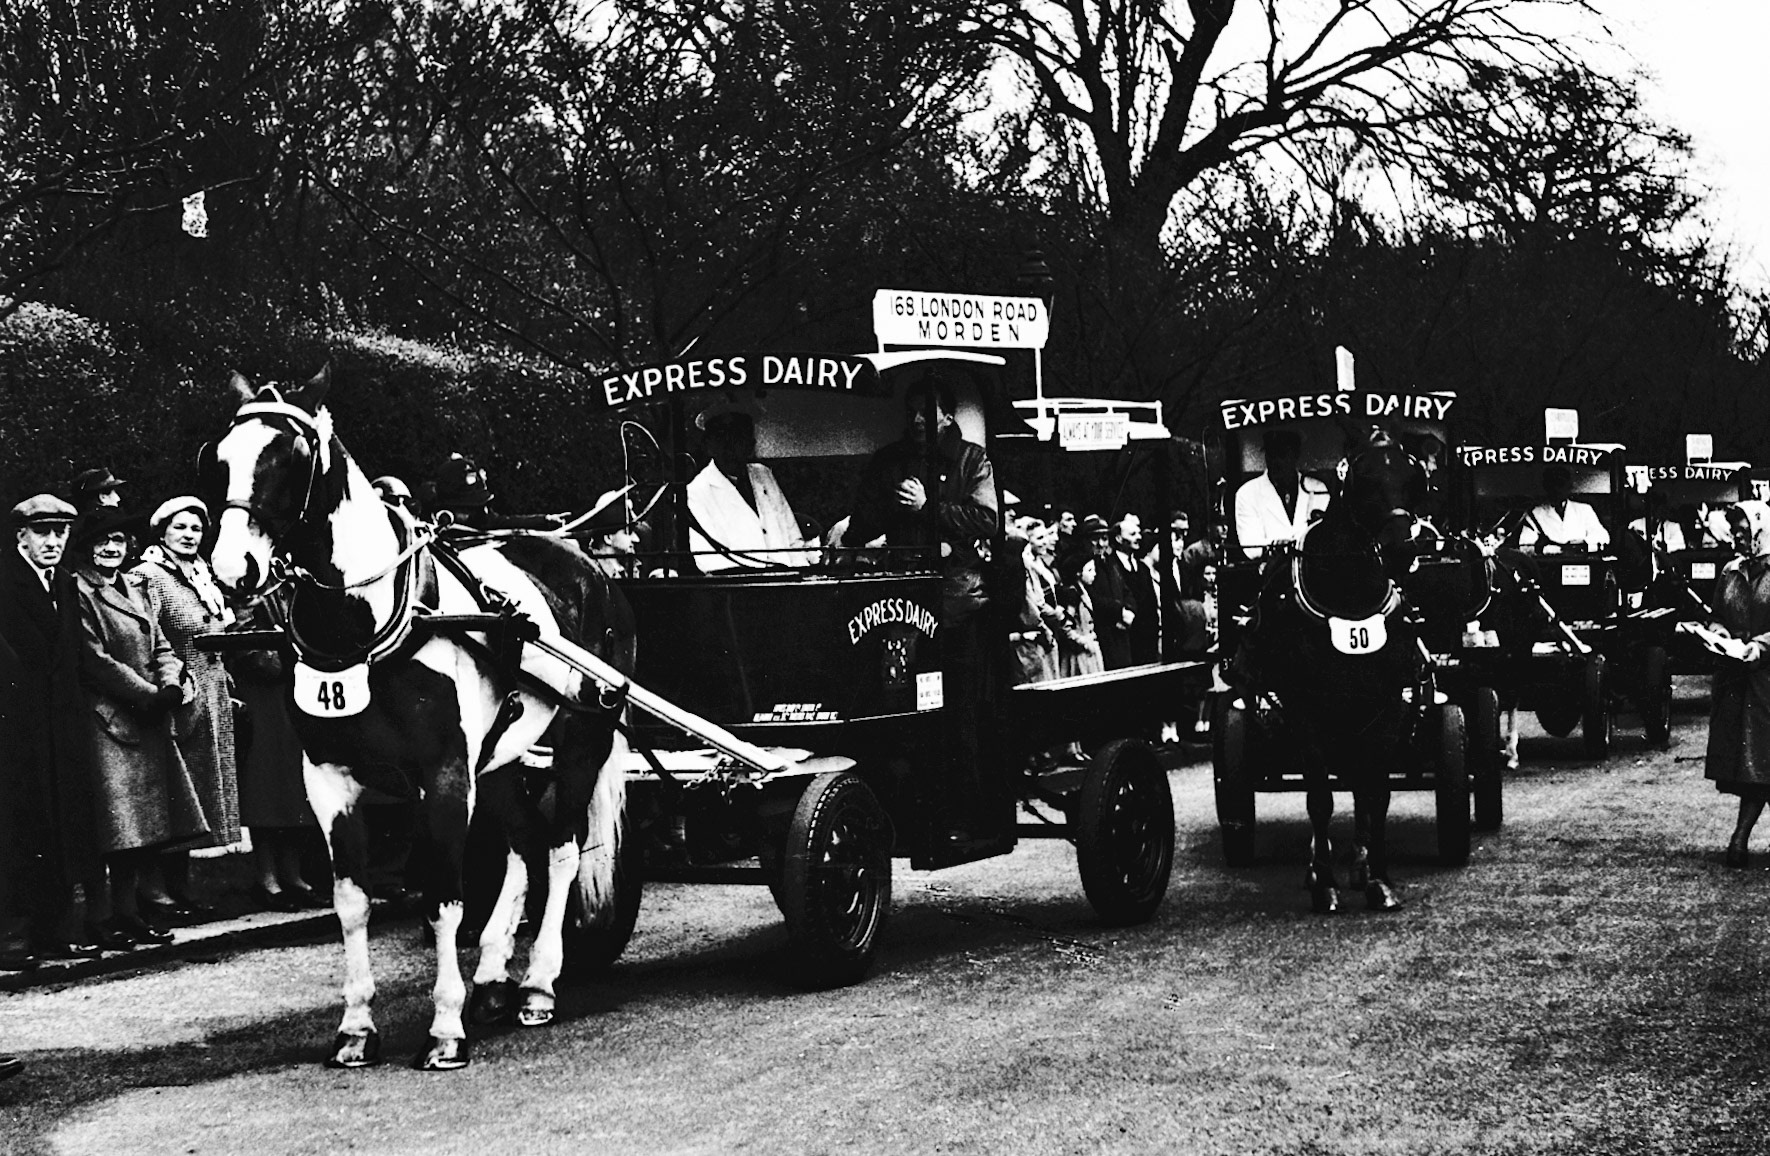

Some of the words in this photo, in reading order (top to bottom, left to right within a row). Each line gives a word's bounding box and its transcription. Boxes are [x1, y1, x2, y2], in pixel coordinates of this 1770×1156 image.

[921, 297, 984, 318] LONDON
[993, 301, 1037, 321] ROAD
[918, 320, 1020, 342] MORDEN
[603, 357, 747, 406] EXPRESS
[763, 356, 863, 390] DAIRY
[1221, 393, 1352, 430] EXPRESS
[1366, 394, 1454, 420] DAIRY
[1543, 446, 1603, 466] DAIRY
[1684, 466, 1732, 482] DAIRY
[847, 597, 904, 646] EXPRESS
[904, 600, 939, 639] DAIRY
[1349, 626, 1369, 650] 50
[317, 680, 346, 711] 48
